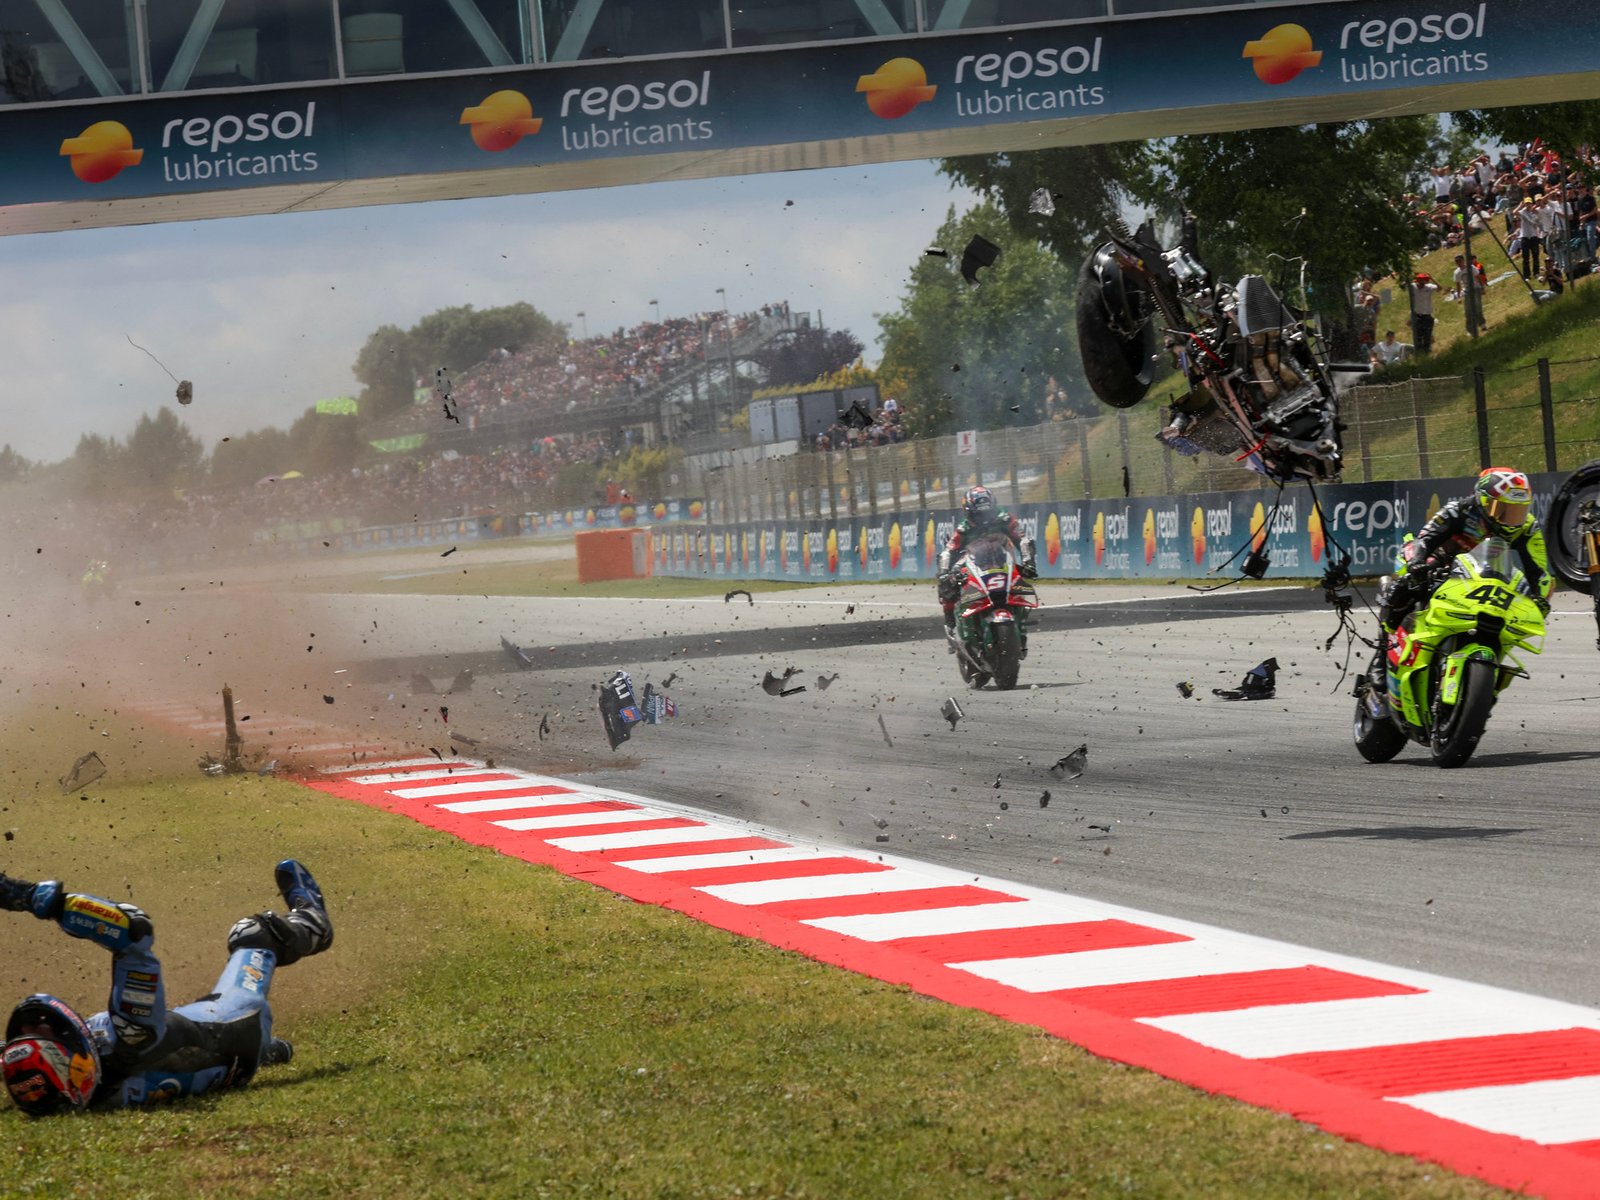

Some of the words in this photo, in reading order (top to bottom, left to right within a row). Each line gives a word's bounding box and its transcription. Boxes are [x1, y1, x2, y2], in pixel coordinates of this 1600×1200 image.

[1341, 3, 1486, 53] repsol
[955, 38, 1102, 87] repsol
[1342, 50, 1489, 82] lubricants
[561, 71, 711, 121] repsol
[957, 85, 1105, 116] lubricants
[163, 102, 315, 152] repsol
[562, 119, 713, 151] lubricants
[163, 150, 319, 182] lubricants
[1333, 490, 1410, 538] repsol
[1465, 585, 1516, 611] 49
